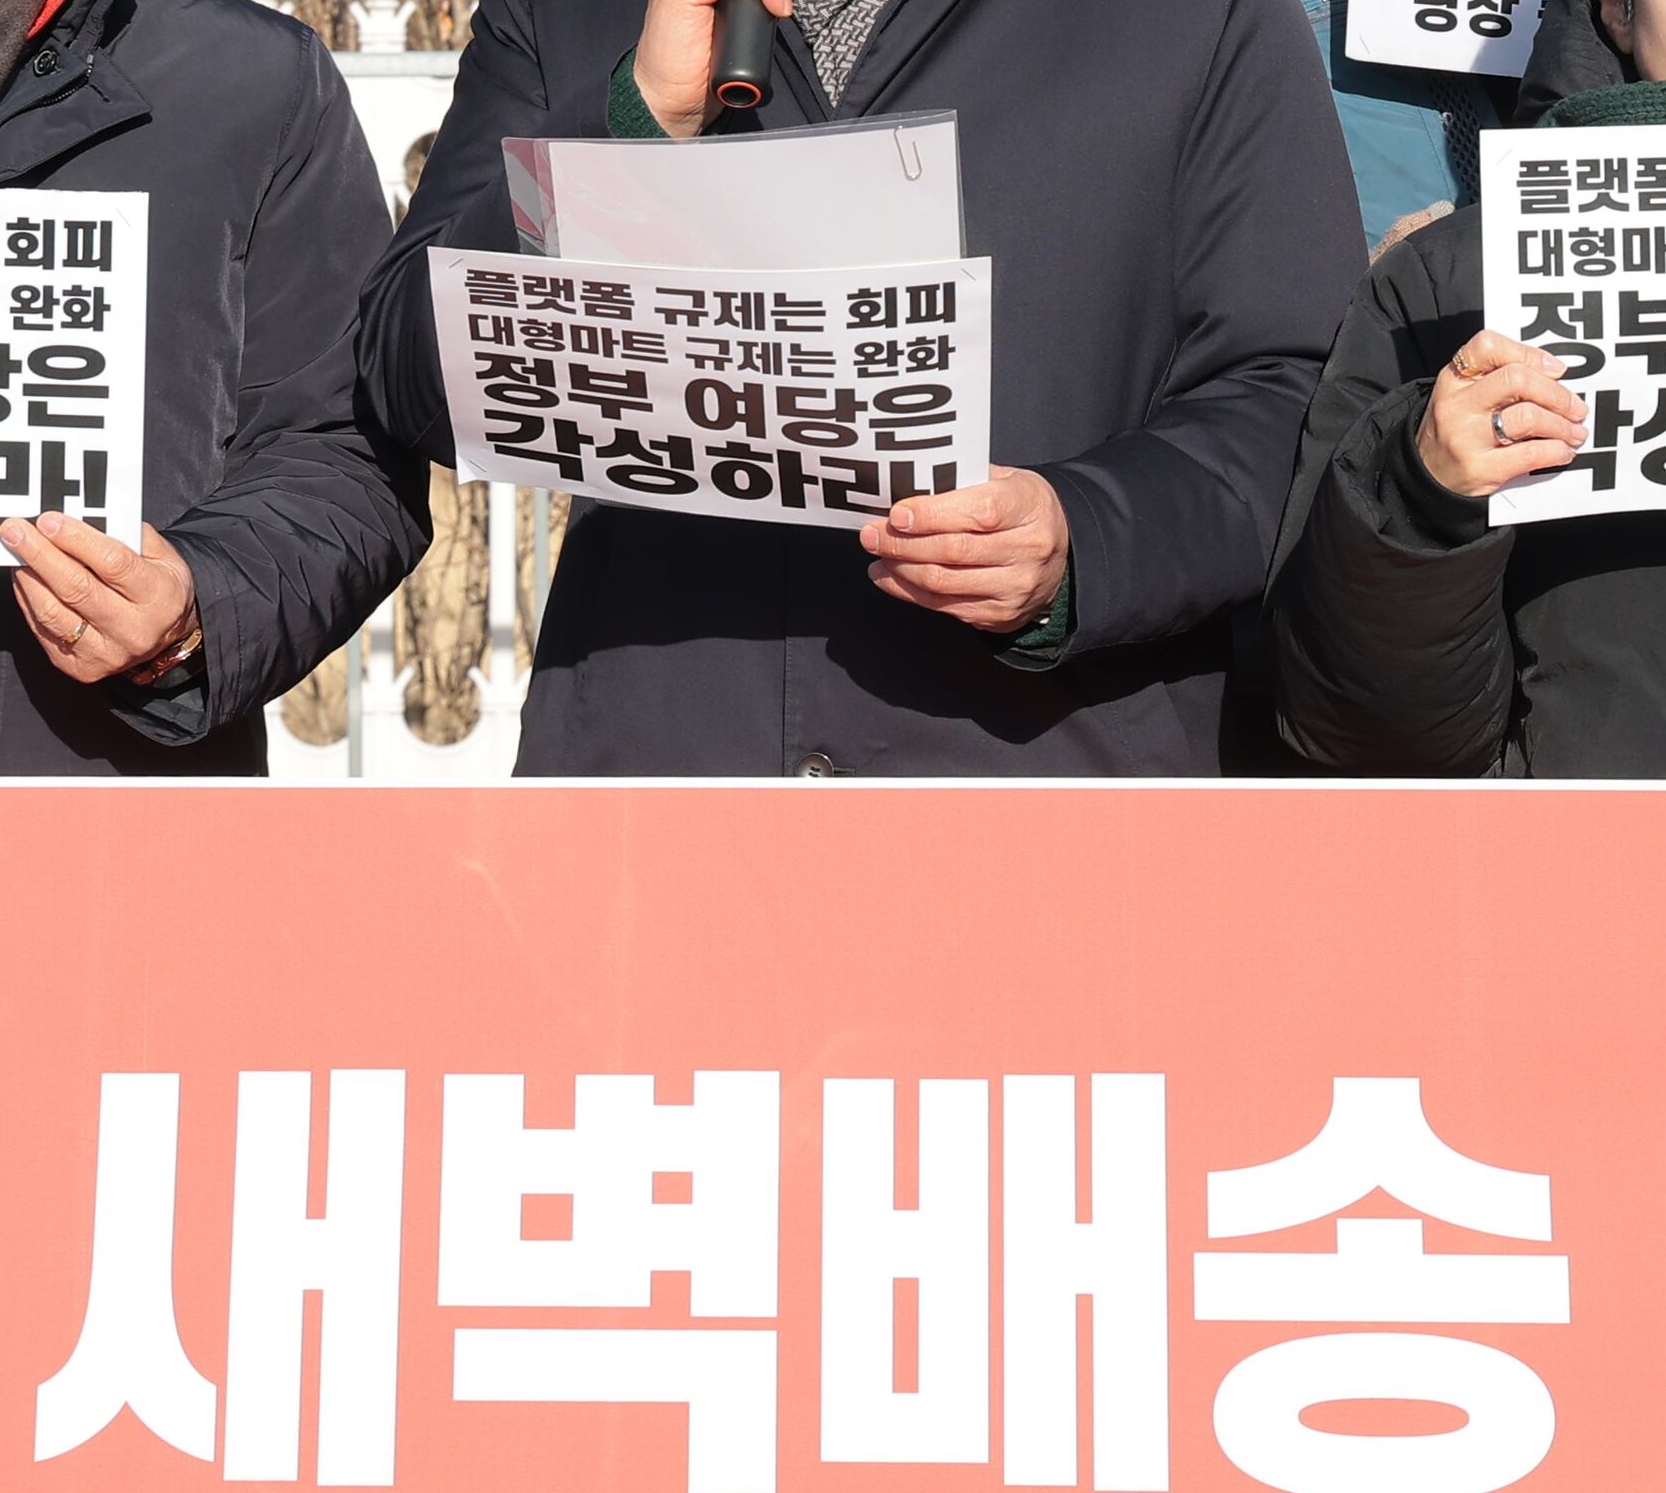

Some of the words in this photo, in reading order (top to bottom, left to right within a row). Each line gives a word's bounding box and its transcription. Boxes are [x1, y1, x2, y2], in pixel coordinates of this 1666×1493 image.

[5, 218, 112, 271] 회피
[10, 285, 110, 331] 완화
[465, 269, 634, 320] 플랫폼
[655, 287, 826, 332] 규제는
[847, 282, 955, 329] 회피
[468, 314, 668, 363] 대형마트
[685, 337, 836, 378] 규제는
[854, 335, 955, 378] 완화
[474, 352, 653, 420] 정부
[685, 379, 956, 451] 여당은
[34, 1069, 1570, 1493] 새벽배송
